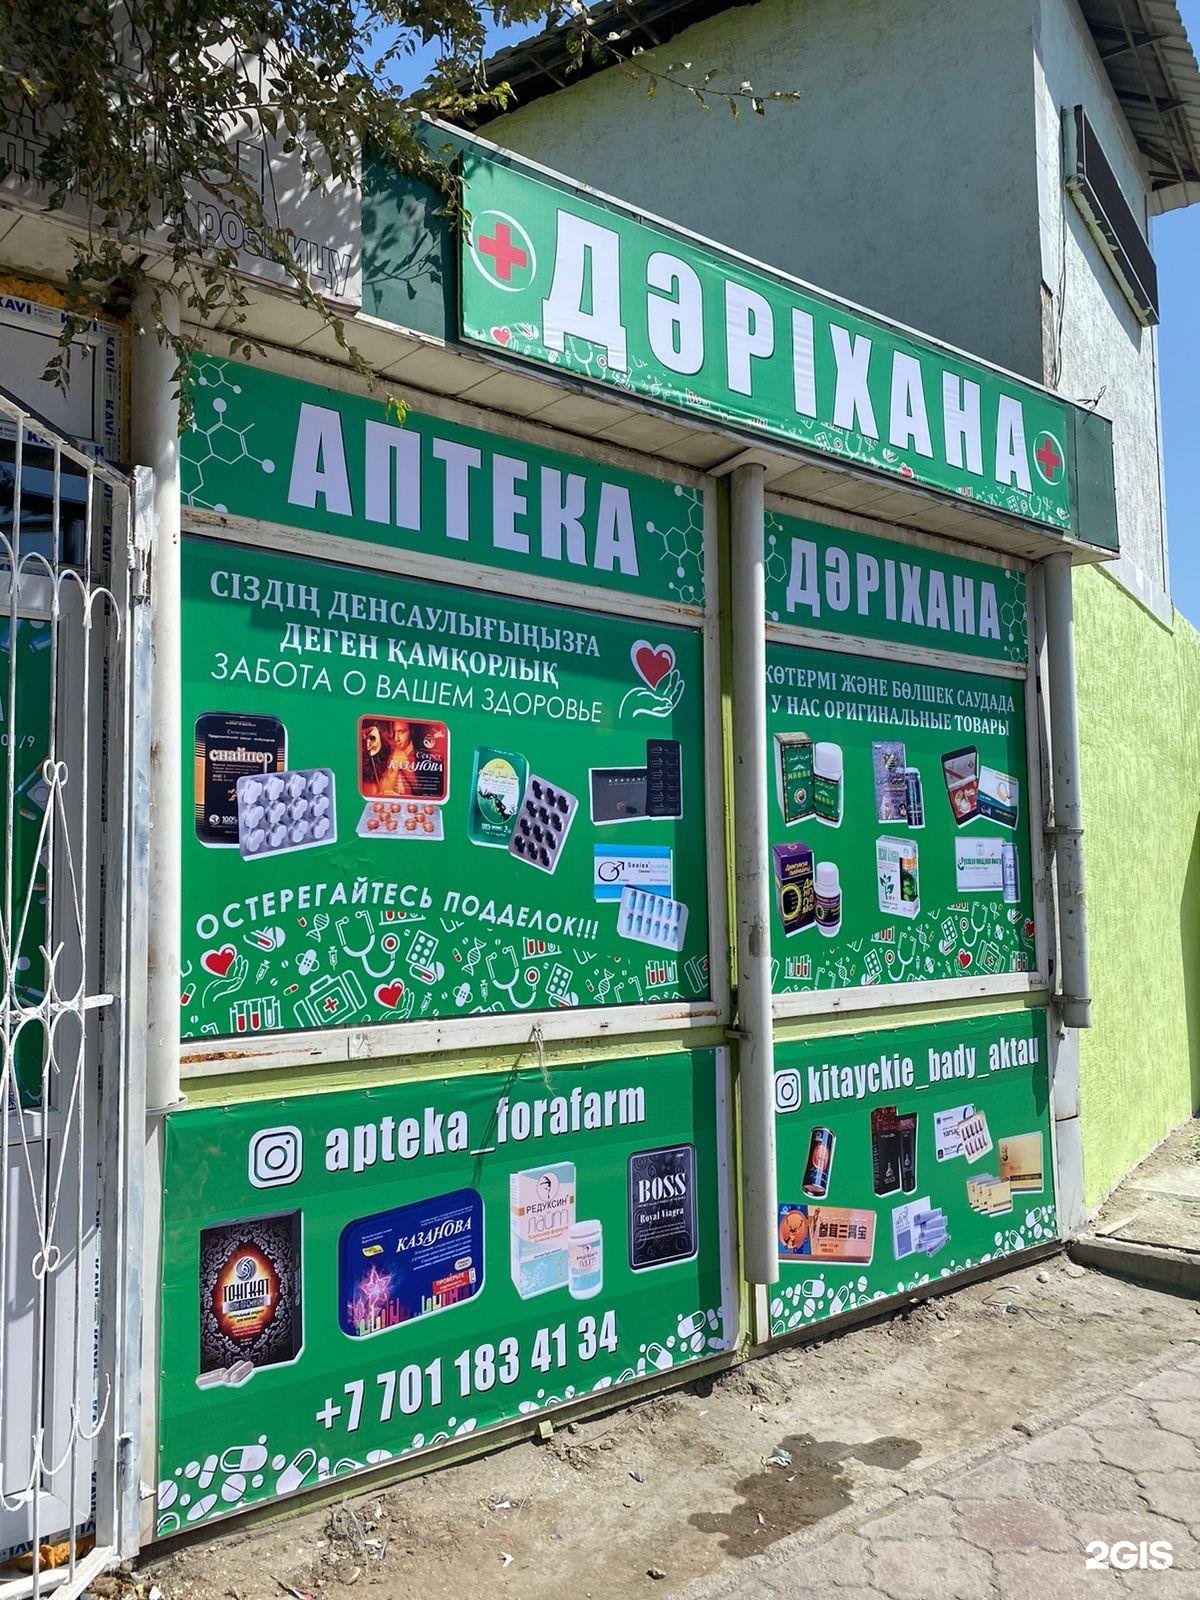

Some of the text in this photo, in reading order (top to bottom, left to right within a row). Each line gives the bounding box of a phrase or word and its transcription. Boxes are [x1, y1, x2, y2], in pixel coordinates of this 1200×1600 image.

[541, 207, 1033, 495] ДӘРІХАНА
[287, 401, 640, 578] АПТЕКА
[210, 570, 601, 657] СІЗДІҢ ДЕНСАУЛЫҒЫҢЫЗҒА
[786, 537, 1001, 640] ДӘРІХАНА
[211, 652, 603, 723] ЗАБОТА О ВАШЕМ ЗДОРОВЬЕ
[280, 622, 559, 689] ДЕГЕН ҚАМҚОРЛЫҚ
[771, 694, 1010, 736] У НАС ОРИГИНАЛЬНЫЕ ТОВАРЫ
[841, 674, 888, 696] ЖӘНЕ
[892, 681, 954, 705] БӨЛШЕК
[957, 689, 1015, 715] САУДАДА
[196, 876, 599, 941] ОСТЕРЕГАЙТЕСЬ ПОДДЕЛОК!!!
[808, 1037, 1040, 1104] kitayckie_bady_aktau
[325, 1086, 647, 1173] apteka_forafarm
[526, 1198, 568, 1214] РЕДУКСИН
[638, 1173, 687, 1204] BOSS
[640, 1207, 684, 1223] Royal Viagra
[396, 1216, 472, 1253] КАЗАНОВА
[316, 1309, 618, 1432] +7 701 183 41 34
